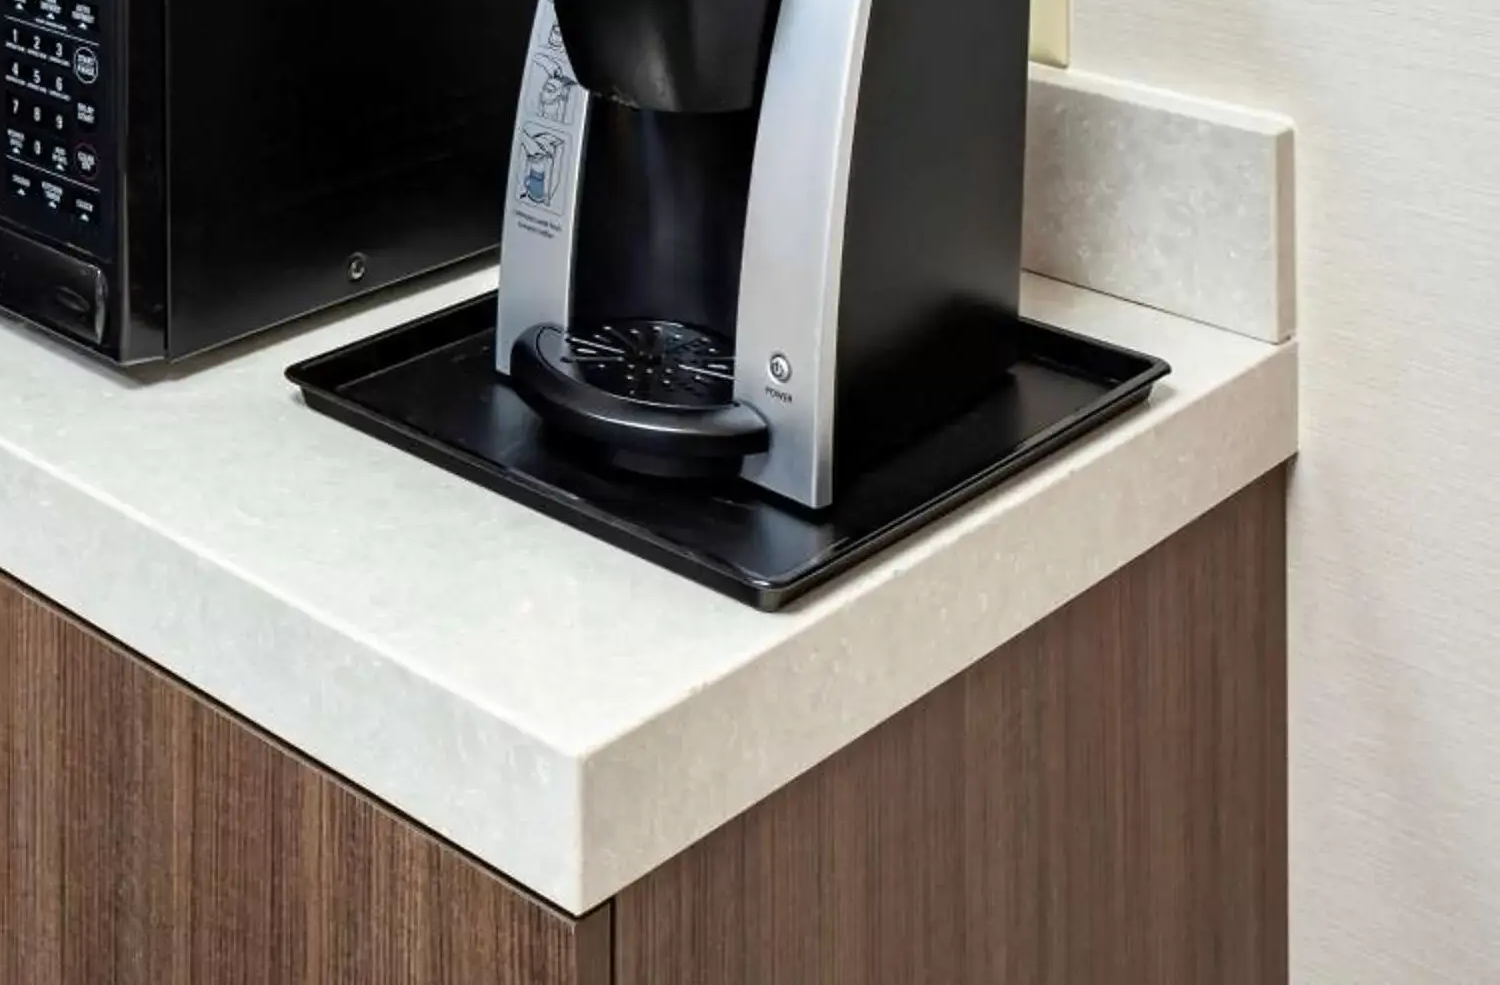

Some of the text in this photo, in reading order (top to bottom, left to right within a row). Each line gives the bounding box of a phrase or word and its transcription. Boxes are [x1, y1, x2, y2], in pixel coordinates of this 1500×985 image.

[12, 28, 18, 43] 1
[33, 35, 41, 50] 2
[55, 42, 64, 57] 3
[12, 62, 19, 77] 4
[33, 69, 41, 84] 5
[55, 76, 64, 92] 6
[12, 98, 19, 114] 7
[33, 106, 42, 122] 8
[55, 114, 64, 130] 9
[34, 140, 42, 155] 0
